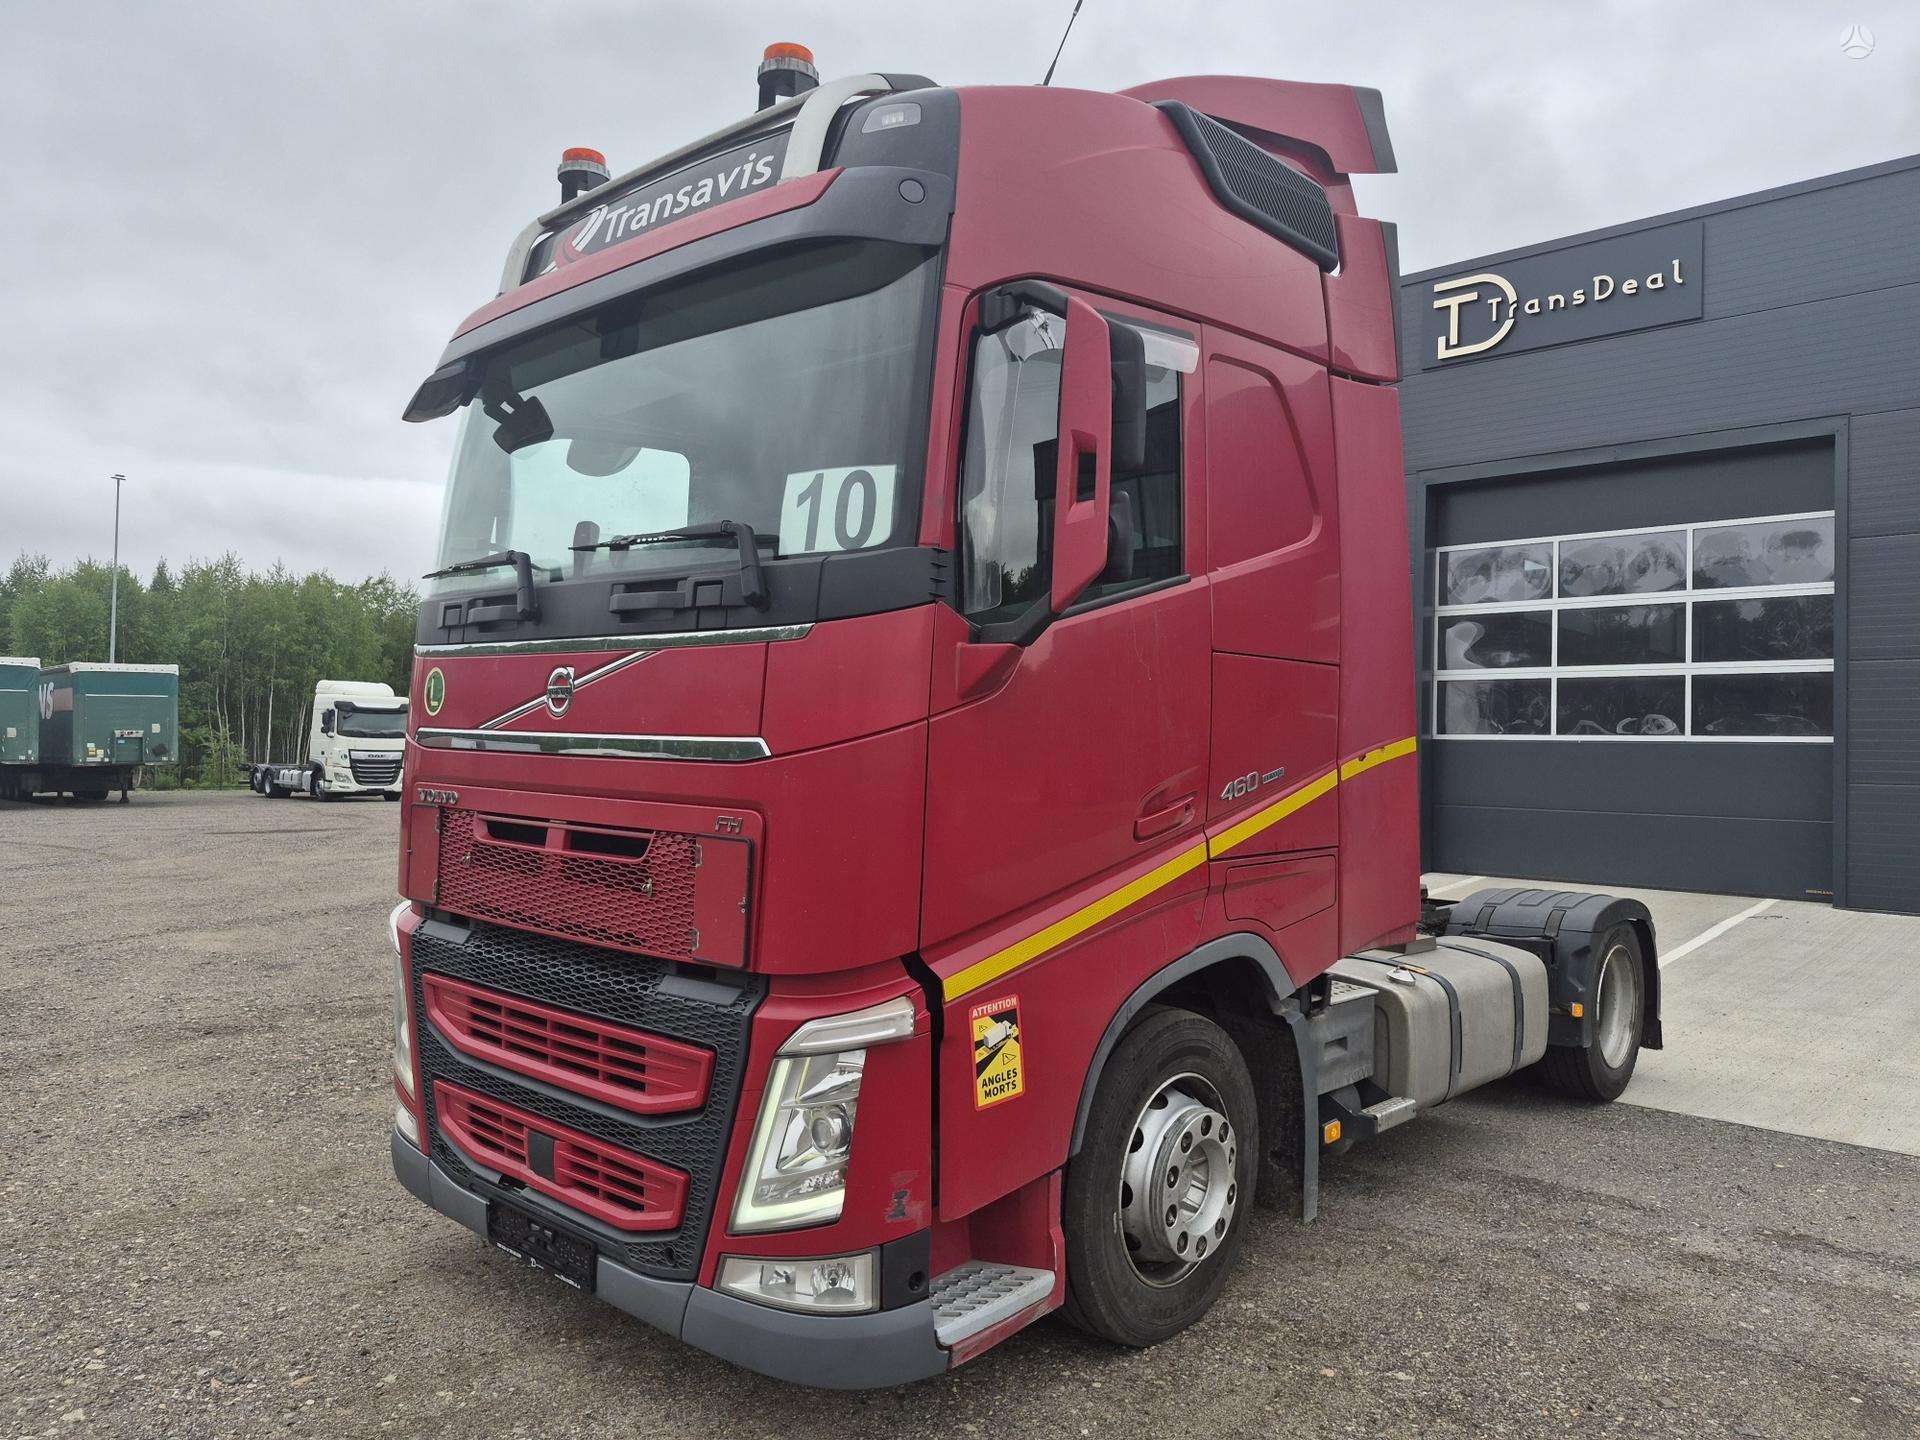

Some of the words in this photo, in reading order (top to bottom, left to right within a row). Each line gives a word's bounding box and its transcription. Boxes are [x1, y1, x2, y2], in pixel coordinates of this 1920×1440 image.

[604, 152, 775, 243] Transavis
[797, 469, 877, 551] 10
[1220, 771, 1259, 801] 460
[715, 815, 743, 833] FH
[972, 997, 1017, 1018] ATTENTION
[982, 1068, 1018, 1088] ANGLES
[984, 1080, 1017, 1099] MORTS
